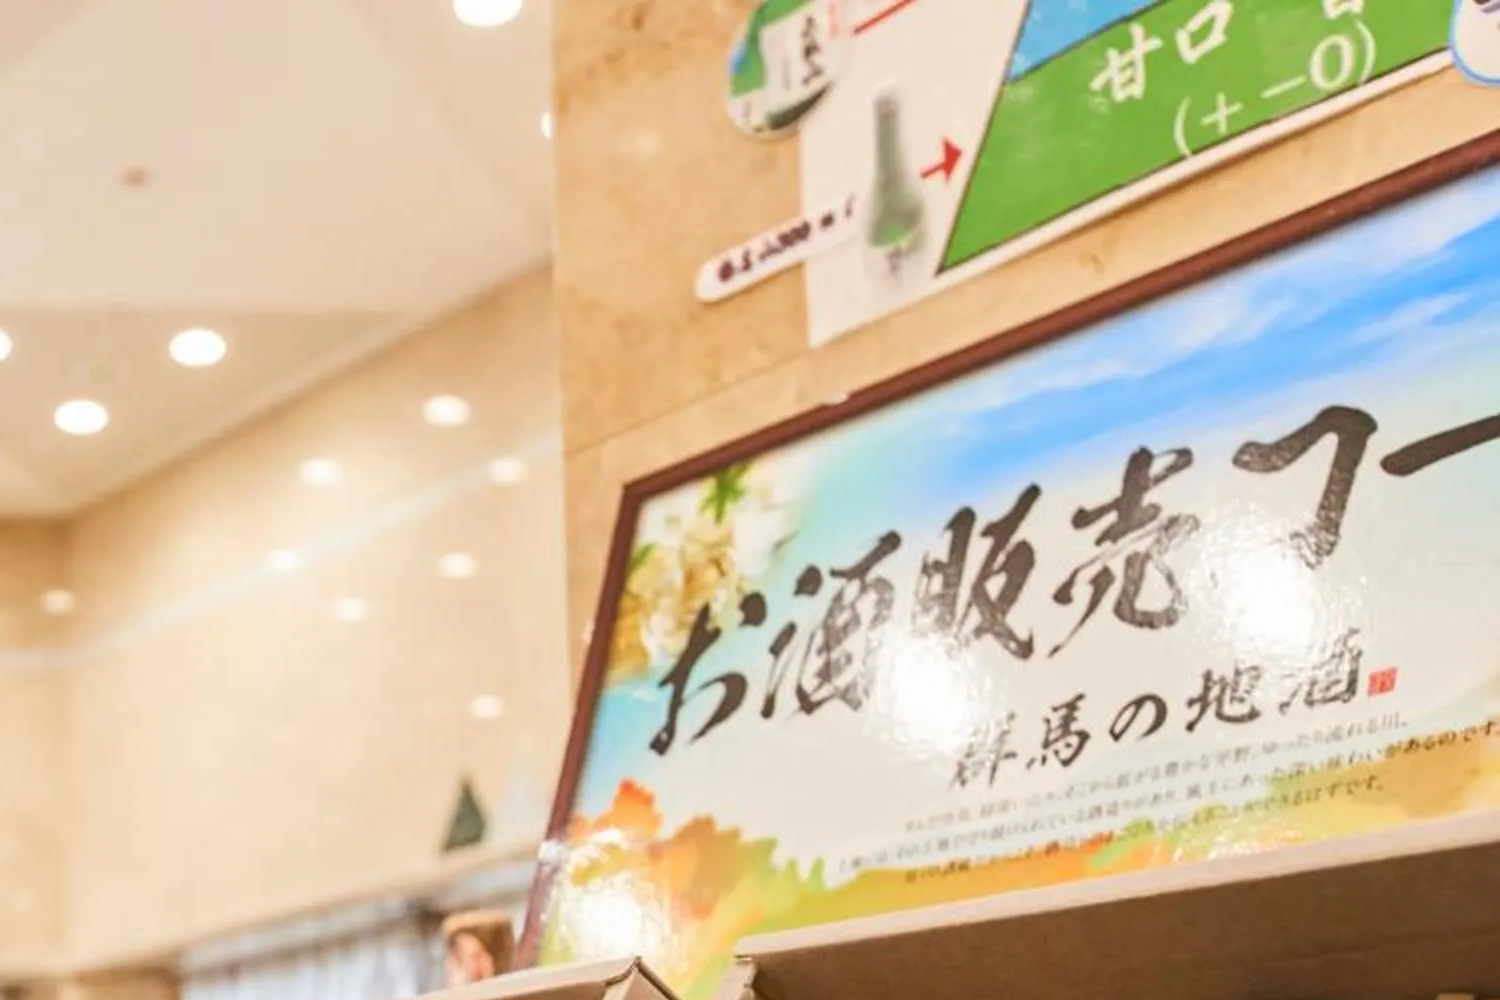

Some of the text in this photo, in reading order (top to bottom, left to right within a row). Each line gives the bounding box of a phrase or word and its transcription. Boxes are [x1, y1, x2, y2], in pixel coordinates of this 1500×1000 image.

[1088, 0, 1234, 104] 甘口
[949, 628, 1365, 788] 群馬の地酒
